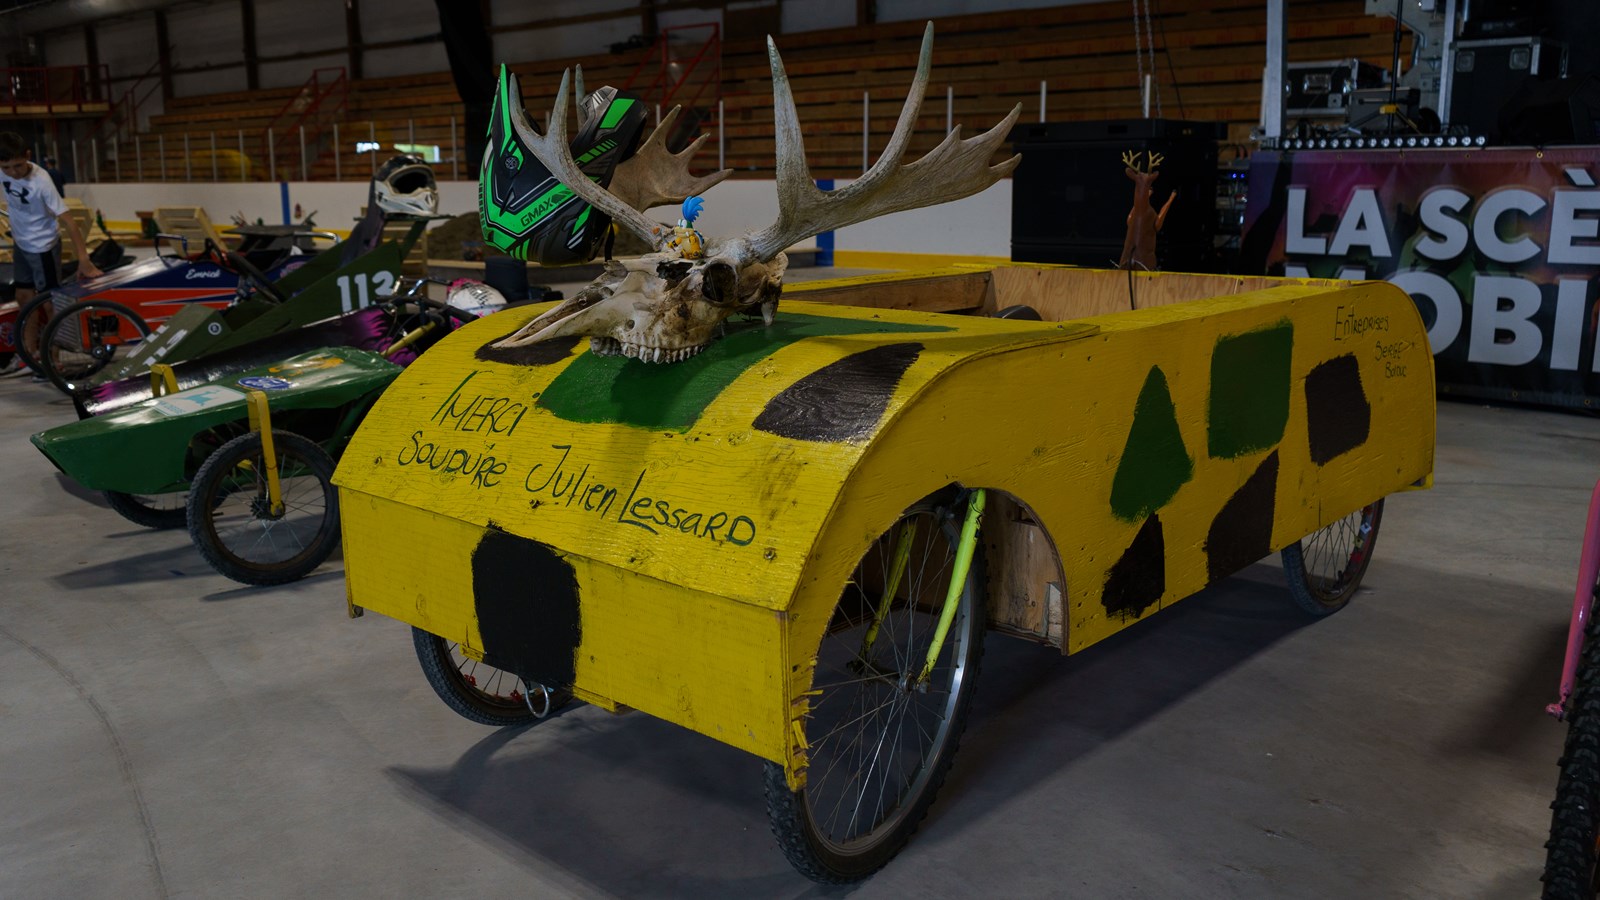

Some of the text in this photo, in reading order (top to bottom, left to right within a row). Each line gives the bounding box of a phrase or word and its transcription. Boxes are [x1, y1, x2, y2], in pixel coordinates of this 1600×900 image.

[520, 199, 556, 228] GMAX
[1285, 168, 1600, 265] LA SCÈ
[1285, 266, 1600, 373] OBI
[525, 444, 616, 519] Julien
